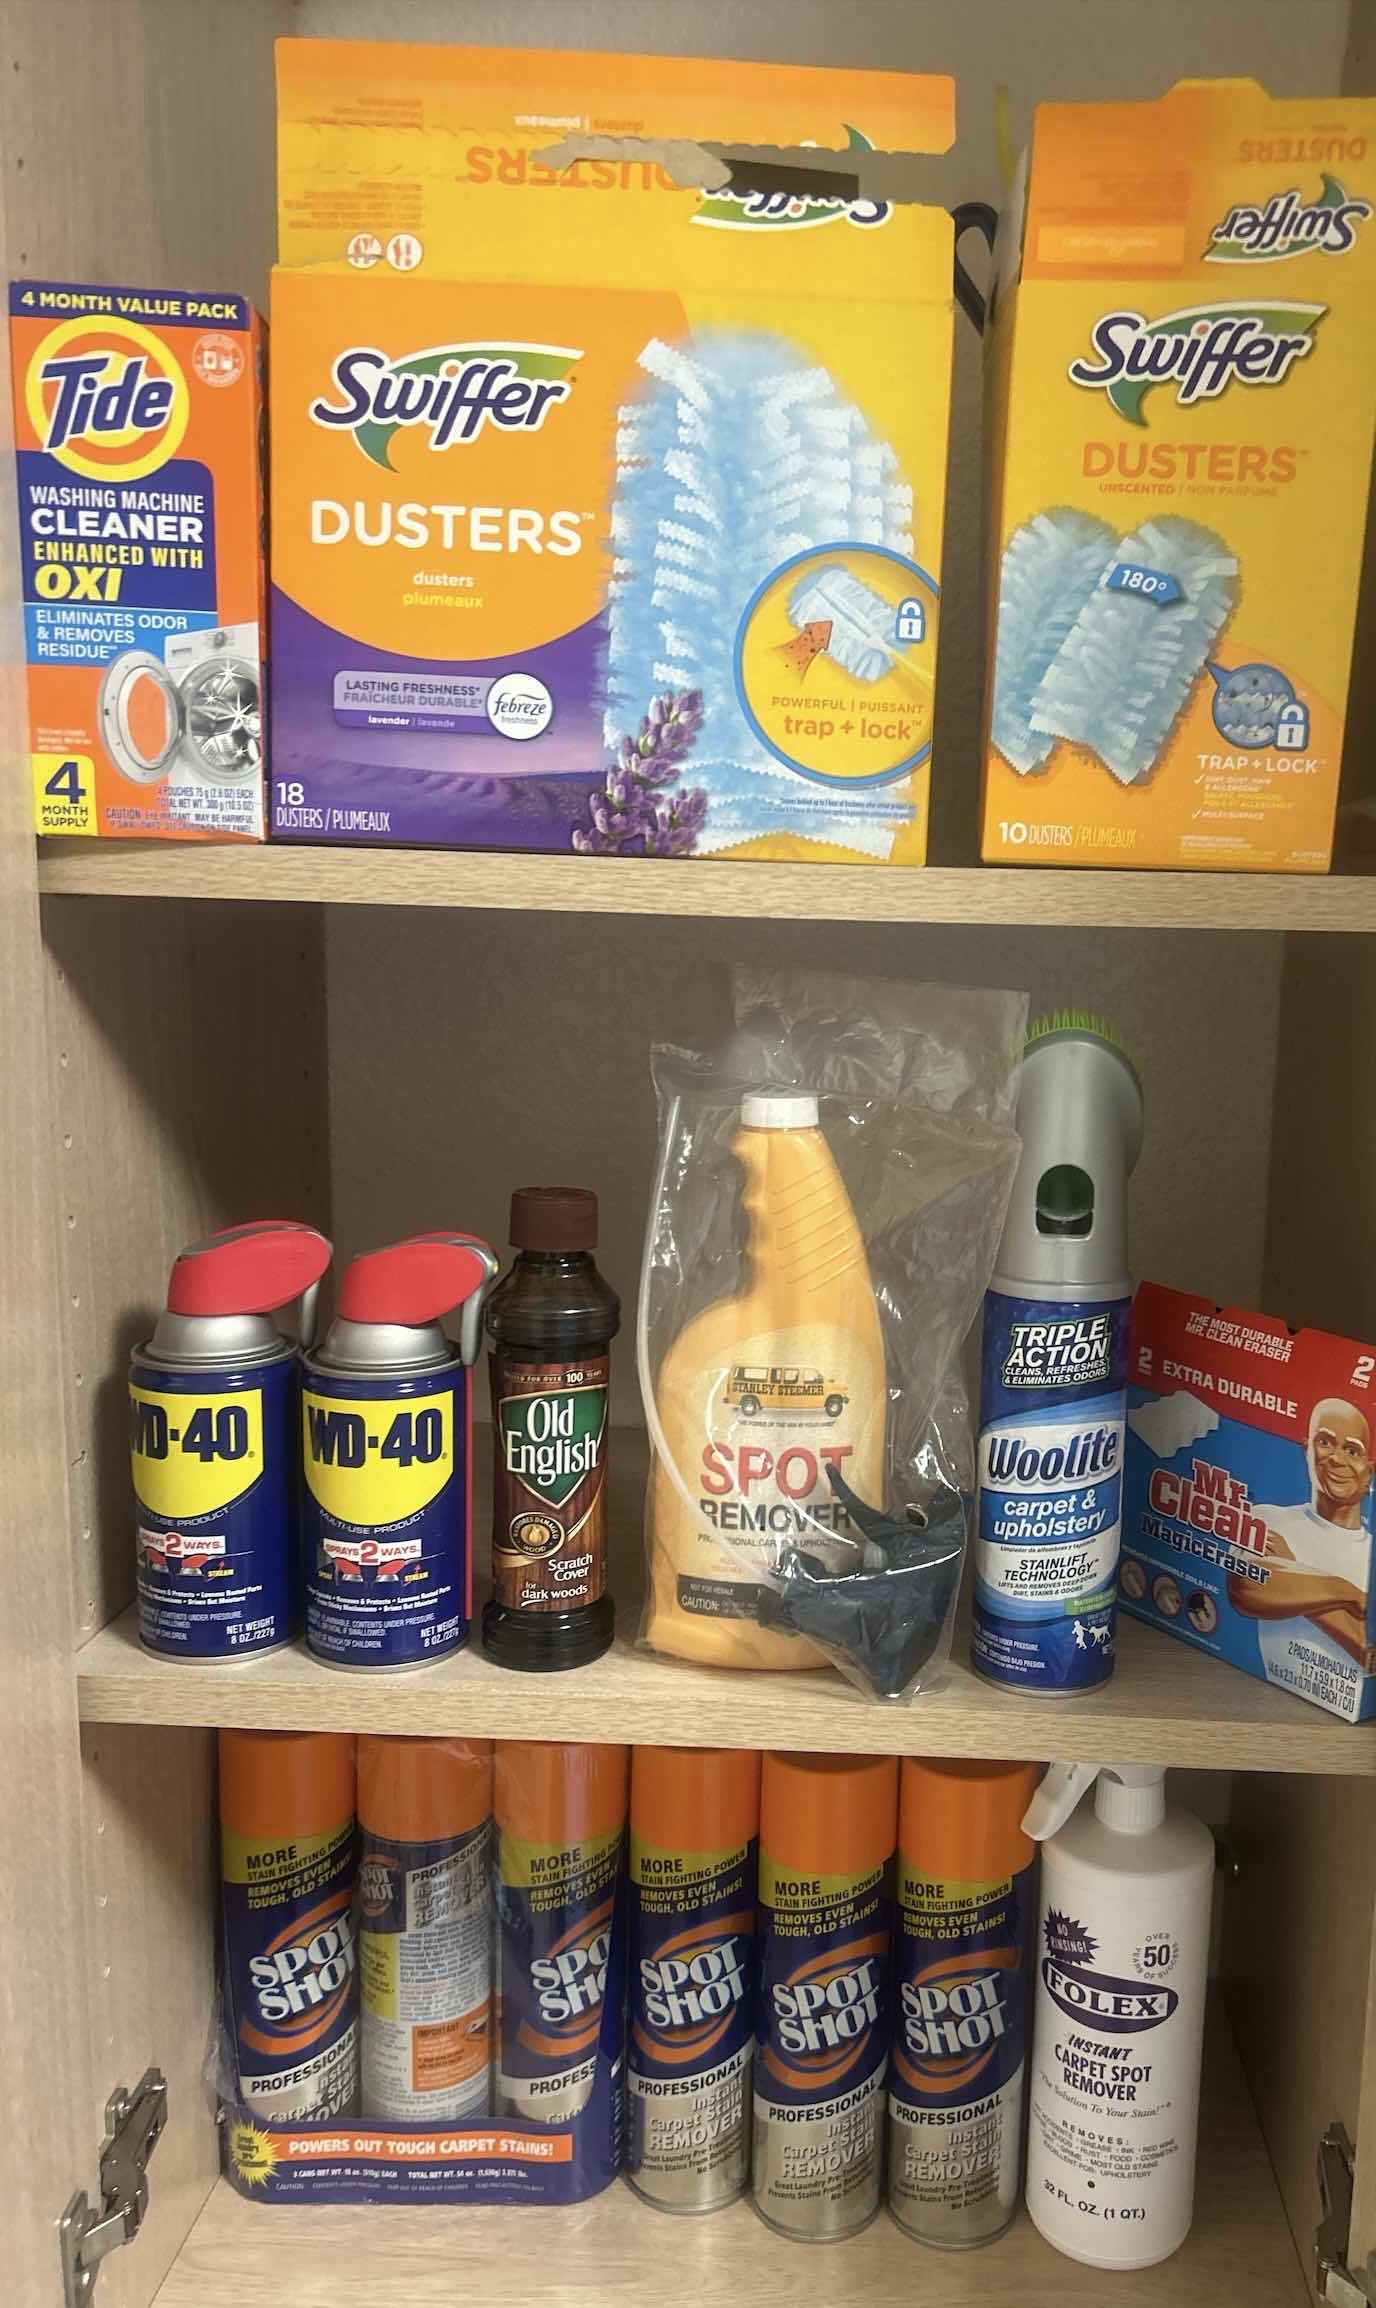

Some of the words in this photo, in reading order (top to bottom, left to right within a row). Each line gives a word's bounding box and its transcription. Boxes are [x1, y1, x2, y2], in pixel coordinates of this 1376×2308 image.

[1240, 137, 1367, 163] DUSTERS
[1213, 194, 1370, 252] Swiffer
[21, 291, 34, 306] 4
[40, 293, 112, 311] MONTH
[117, 297, 181, 315] VALUE
[186, 302, 238, 319] PACK
[1071, 316, 1306, 399] Swiffer
[41, 355, 174, 451] Tide
[313, 352, 565, 446] Swiffer
[1082, 441, 1297, 483] DUSTERS
[30, 486, 116, 509] WASHING
[121, 491, 205, 514] MACHINE
[30, 508, 204, 543] CLEANER
[34, 541, 144, 565] ENHANCED
[151, 547, 204, 568] WITH
[34, 563, 123, 601] OXI
[413, 572, 475, 587] dusters
[402, 592, 484, 608] plumeaux
[36, 610, 135, 627] ELIMINATES
[138, 614, 188, 629] ODOR
[36, 626, 49, 640] &
[54, 628, 135, 643] REMOVES
[493, 692, 547, 716] febreze
[770, 696, 847, 711] POWERFUL
[858, 701, 925, 715] PUISSANT
[1197, 753, 1248, 769] TRAP
[1265, 758, 1319, 774] LOCK
[44, 761, 87, 804] 4
[276, 782, 305, 806] 18
[42, 805, 88, 816] MONTH
[43, 816, 88, 828] SUPPLY
[276, 807, 323, 829] DUSTERS
[333, 809, 392, 832] PLUMEAUX
[1013, 1317, 1106, 1347] TRIPLE
[1184, 1322, 1205, 1336] MR.
[1206, 1328, 1243, 1349] CLEAN
[1244, 1339, 1292, 1363] ERASER
[1189, 1311, 1209, 1327] THE
[1211, 1318, 1242, 1337] MOST
[1241, 1328, 1295, 1352] DURABLE
[1007, 1337, 1109, 1368] ACTION
[565, 1371, 584, 1384] 100
[1004, 1376, 1012, 1384] &
[1012, 1374, 1071, 1385] ELIMINATES
[1073, 1366, 1107, 1382] ODORS
[1353, 1355, 1376, 1382] 2
[732, 1382, 775, 1395] STANLEY
[778, 1384, 824, 1396] STEEMER
[1162, 1359, 1214, 1391] EXTRA
[1217, 1377, 1299, 1419] DURABLE
[527, 1397, 574, 1443] Old
[307, 1404, 443, 1469] WD-40
[506, 1430, 599, 1486] English
[988, 1428, 1118, 1482] Woolite
[700, 1441, 853, 1500] SPOT
[1193, 1458, 1251, 1510] Mr.
[176, 1508, 230, 1527] PRODUCT
[700, 1499, 850, 1532] REMOVER
[1004, 1494, 1078, 1521] carpet
[1081, 1488, 1098, 1510] &
[1150, 1468, 1270, 1556] Clean
[319, 1507, 371, 1535] MULTI-USE
[374, 1510, 425, 1534] PRODUCT
[993, 1508, 1107, 1541] upholstery
[165, 1533, 182, 1556] 2
[184, 1540, 220, 1550] WAYS
[325, 1543, 360, 1556] SPRAYS
[360, 1541, 379, 1564] 2
[381, 1545, 416, 1556] WAYS
[522, 1544, 547, 1554] WOOD
[547, 1552, 593, 1572] Scratch
[553, 1566, 590, 1582] Cover
[1019, 1552, 1088, 1570] STAINLIFT
[521, 1587, 549, 1600] dark
[550, 1583, 588, 1599] woods
[525, 1581, 537, 1590] for
[998, 1581, 1013, 1590] LIFTS
[1014, 1582, 1027, 1590] AND
[1028, 1582, 1061, 1590] REMOVES
[1030, 1589, 1053, 1597] STAINS
[681, 1594, 719, 1611] CAUTION:
[226, 1622, 243, 1635] NET
[244, 1615, 275, 1631] WEIGHT
[420, 1625, 435, 1637] NET
[436, 1615, 459, 1633] WEIGHT
[640, 1857, 683, 1874] MORE
[774, 1879, 820, 1897] MORE
[903, 1879, 944, 1899] MORE
[903, 1897, 925, 1910] STAIN
[927, 1896, 974, 1912] FIGHTING
[975, 1882, 1010, 1905] POWER
[903, 1911, 946, 1927] REMOVES
[948, 1911, 978, 1927] EVEN
[903, 1923, 935, 1941] TOUGH,
[936, 1926, 960, 1939] OLD
[962, 1911, 1007, 1937] STAINS!
[1056, 1922, 1069, 1937] NO
[250, 1911, 352, 1989] SPOT
[1050, 1937, 1088, 1954] RINSING!
[1145, 1932, 1171, 1943] OVER
[640, 1935, 740, 1993] SPOT
[1143, 1944, 1170, 1968] 50
[258, 1937, 356, 2021] SHOT
[772, 1957, 875, 2018] SPOT
[1050, 1968, 1160, 2017] FOLEX
[645, 1962, 746, 2028] SHOT
[901, 1971, 1001, 2020] SPOT
[778, 1984, 880, 2053] SHOT
[905, 1999, 1007, 2055] SHOT
[1068, 2034, 1134, 2062] INSTANT
[637, 2055, 744, 2097] PROFESSIONAL
[1054, 2043, 1107, 2080] CARPET
[1111, 2065, 1153, 2083] SPOT
[1063, 2066, 1137, 2102] REMOVER
[769, 2079, 877, 2123] PROFESSIONAL
[895, 2094, 1003, 2127] PROFESSIONAL
[649, 2107, 744, 2150] REMOVER
[288, 2137, 350, 2155] POWERS
[353, 2139, 384, 2154] OUT
[387, 2140, 436, 2155] TOUGH
[439, 2137, 497, 2155] CARPET
[498, 2138, 555, 2157] STAINS!
[782, 2129, 875, 2178] REMOVER
[1080, 2138, 1113, 2153] GREASE
[1142, 2144, 1158, 2154] RED
[1080, 2147, 1101, 2160] RUST
[1109, 2154, 1133, 2162] FOOD
[1043, 2178, 1056, 2196] 32
[1056, 2189, 1075, 2207] FL.
[1077, 2200, 1101, 2217] OZ.
[1103, 2207, 1115, 2221] (1
[1120, 2207, 1146, 2221] QT.)
